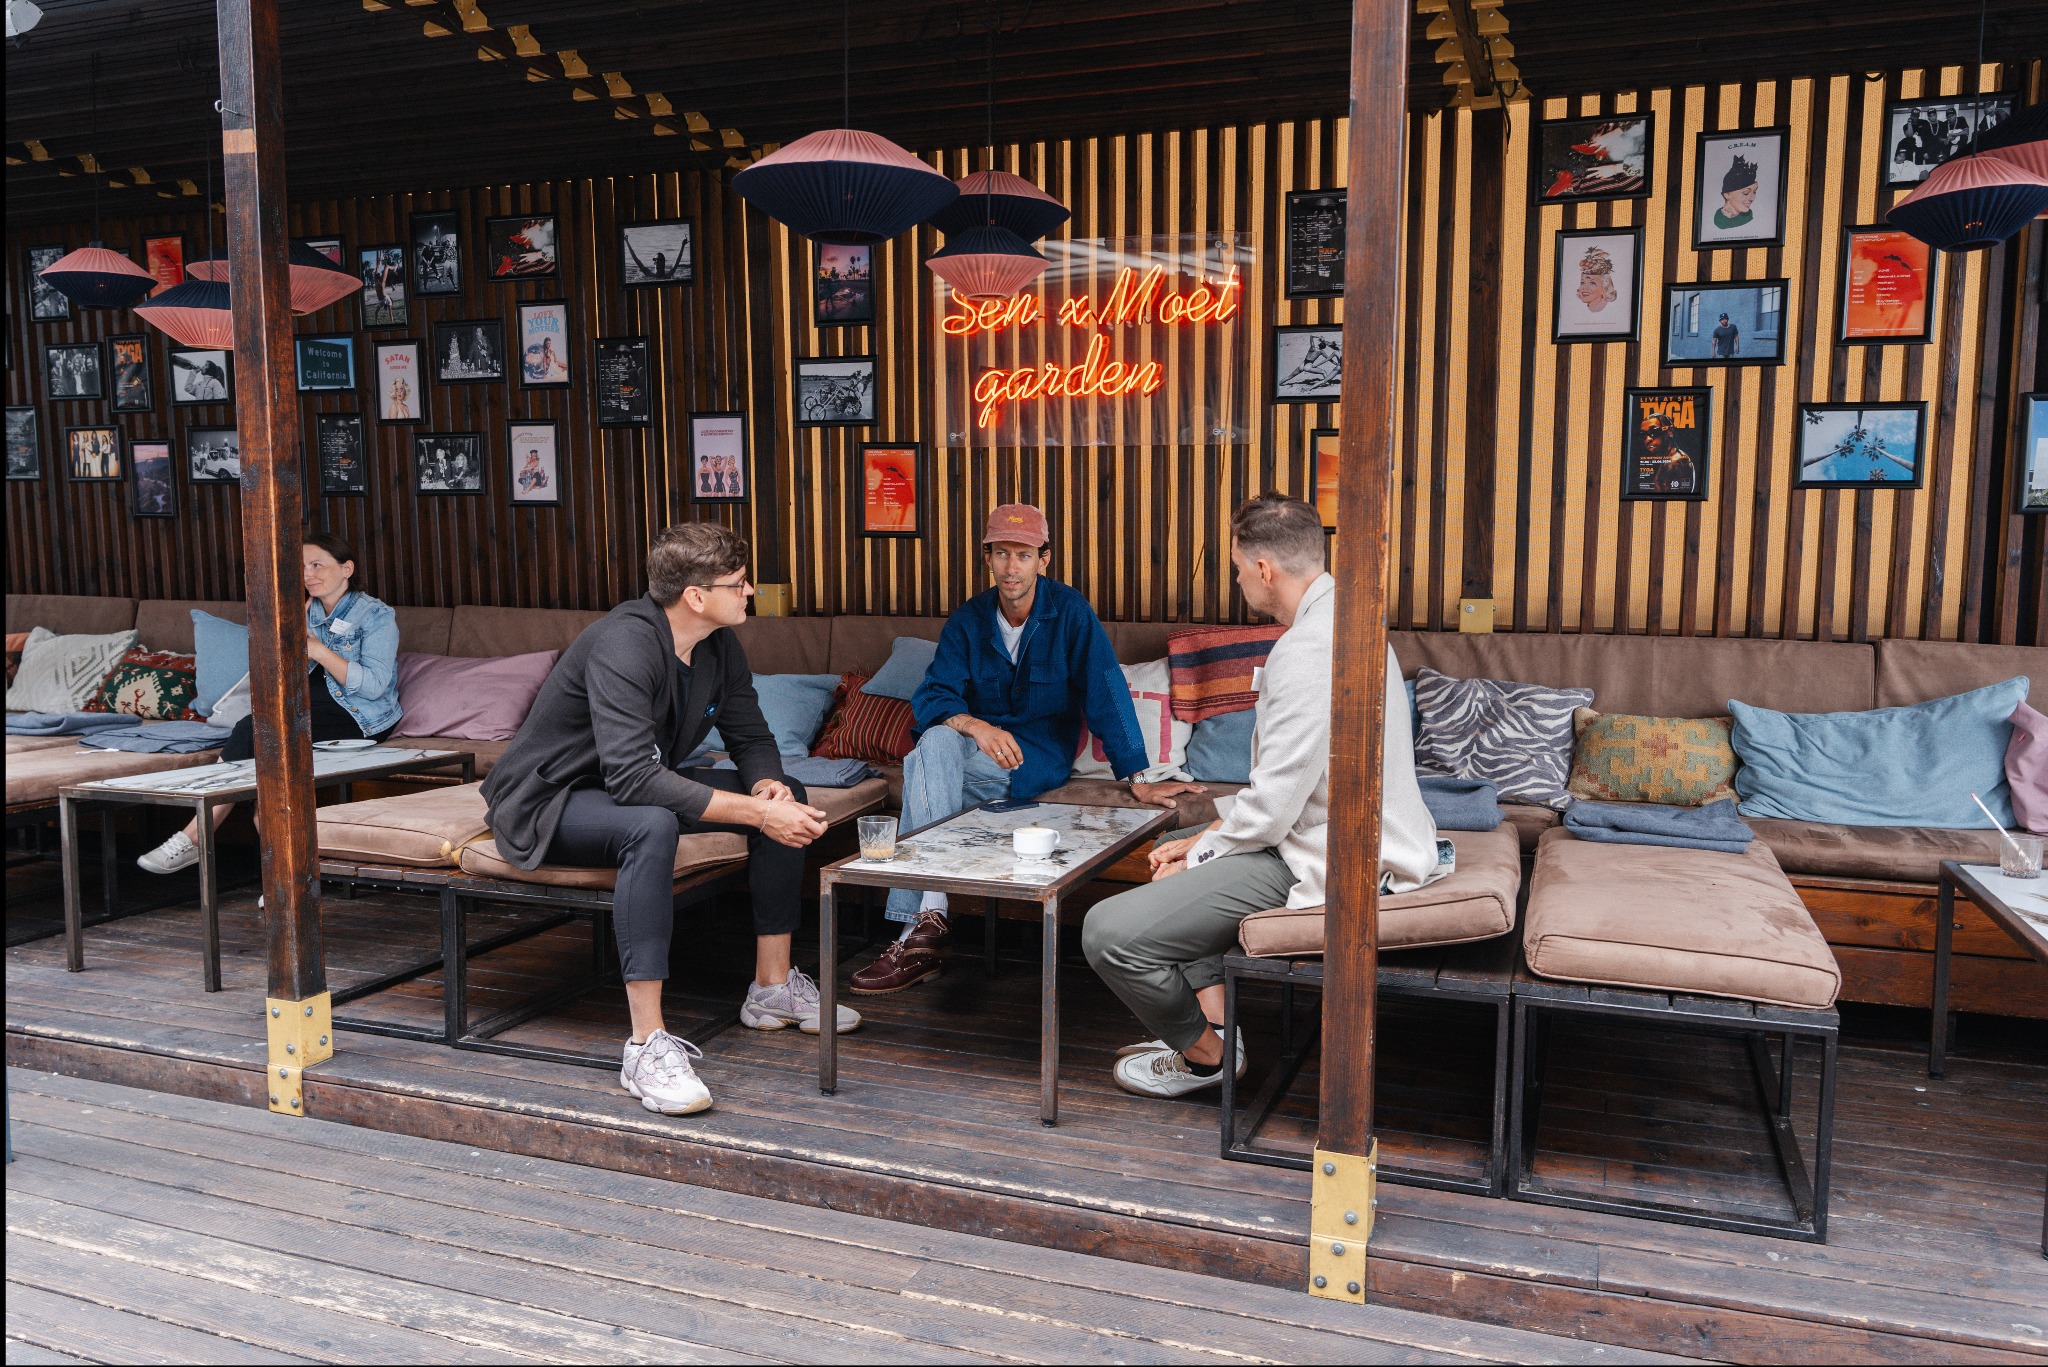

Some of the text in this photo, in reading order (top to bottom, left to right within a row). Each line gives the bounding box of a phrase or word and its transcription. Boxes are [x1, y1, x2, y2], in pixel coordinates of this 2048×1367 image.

[534, 310, 553, 319] LOVE
[942, 287, 1038, 334] Sen
[1060, 296, 1092, 325] x
[528, 316, 558, 328] YOUR
[528, 326, 560, 335] MOTHER
[116, 344, 143, 363] TYGA
[308, 346, 342, 358] Welcome
[384, 354, 410, 364] SATAN
[306, 370, 346, 380] California
[975, 333, 1162, 428] garden
[1640, 401, 1695, 428] TYGA
